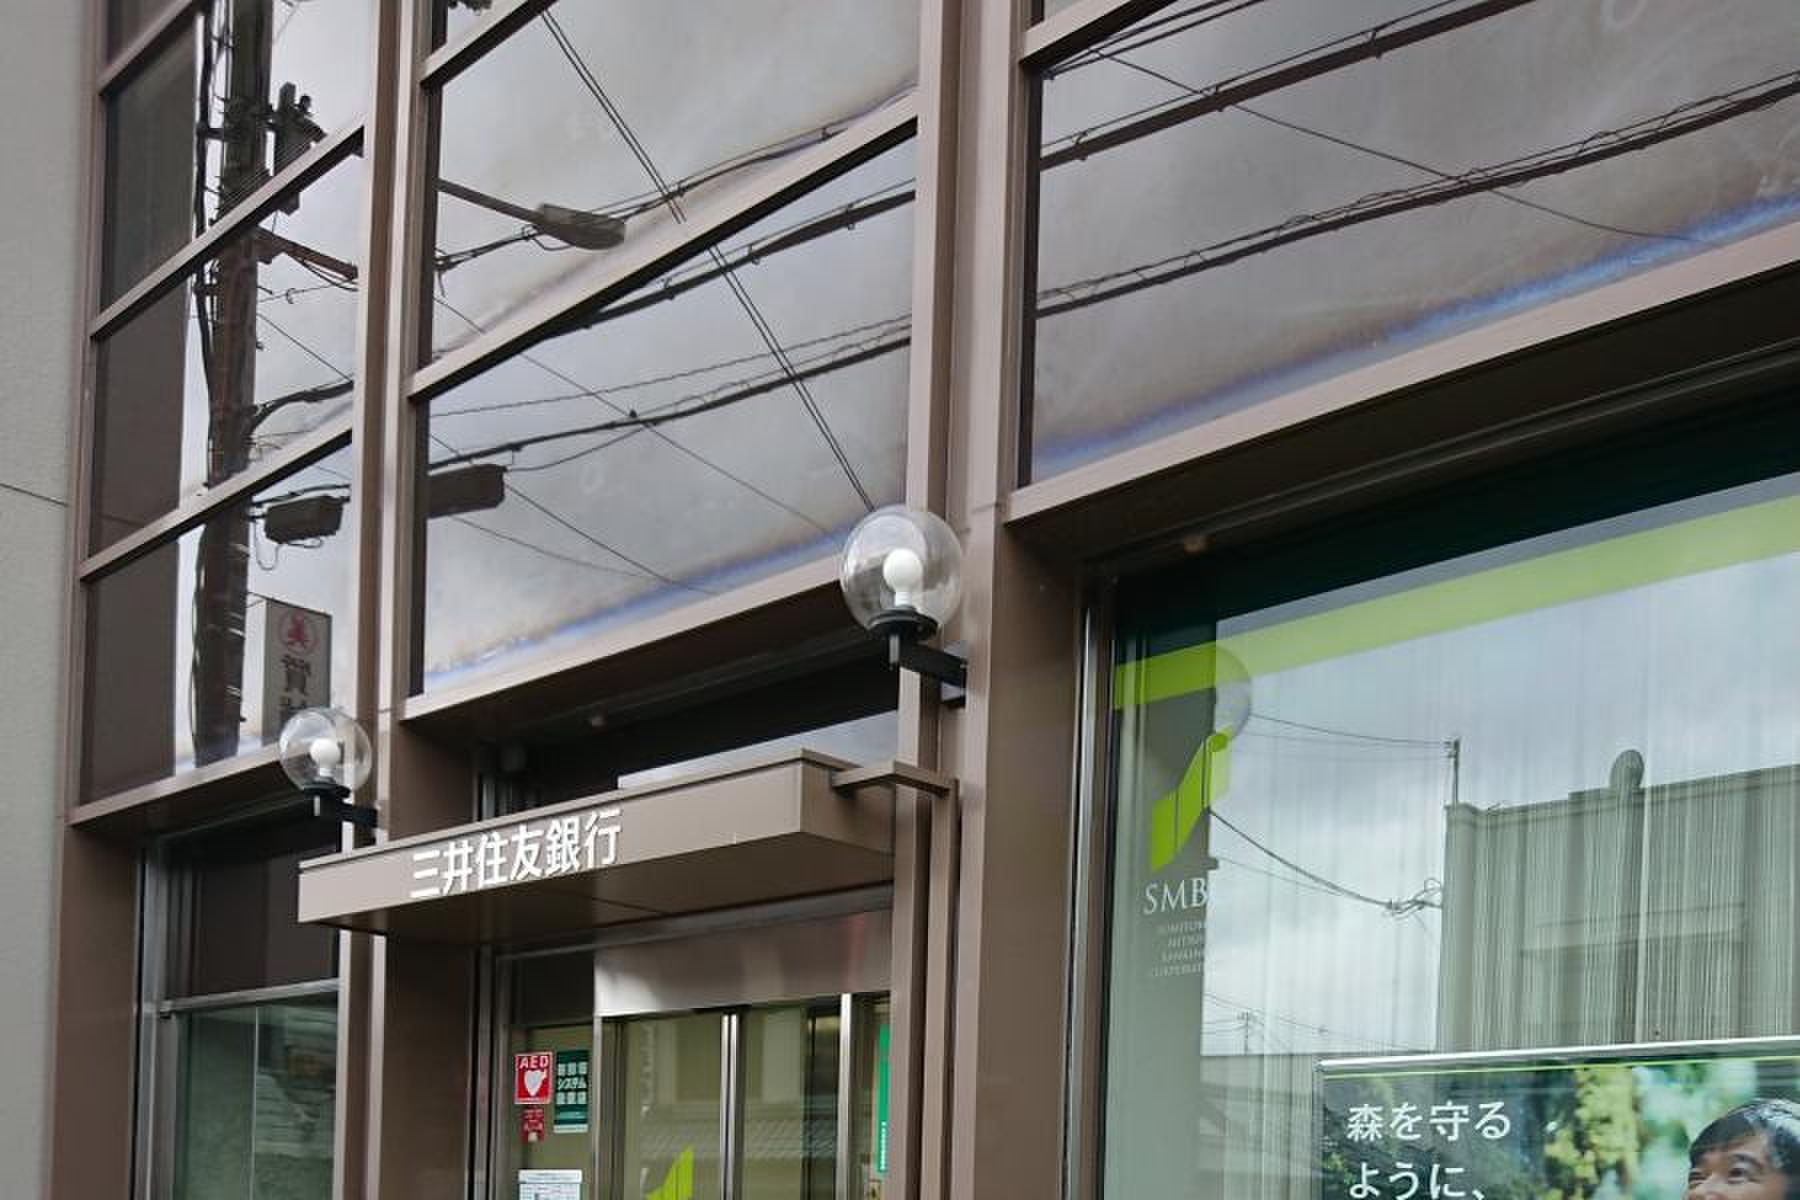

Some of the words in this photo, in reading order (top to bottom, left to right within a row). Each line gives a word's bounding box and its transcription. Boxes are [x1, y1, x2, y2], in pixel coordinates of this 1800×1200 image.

[409, 809, 623, 898] 三井住友銀行
[1143, 877, 1212, 915] SMB
[519, 1055, 549, 1069] AED
[1346, 1100, 1512, 1142] 森を守る
[1347, 1162, 1486, 1200] ように、
